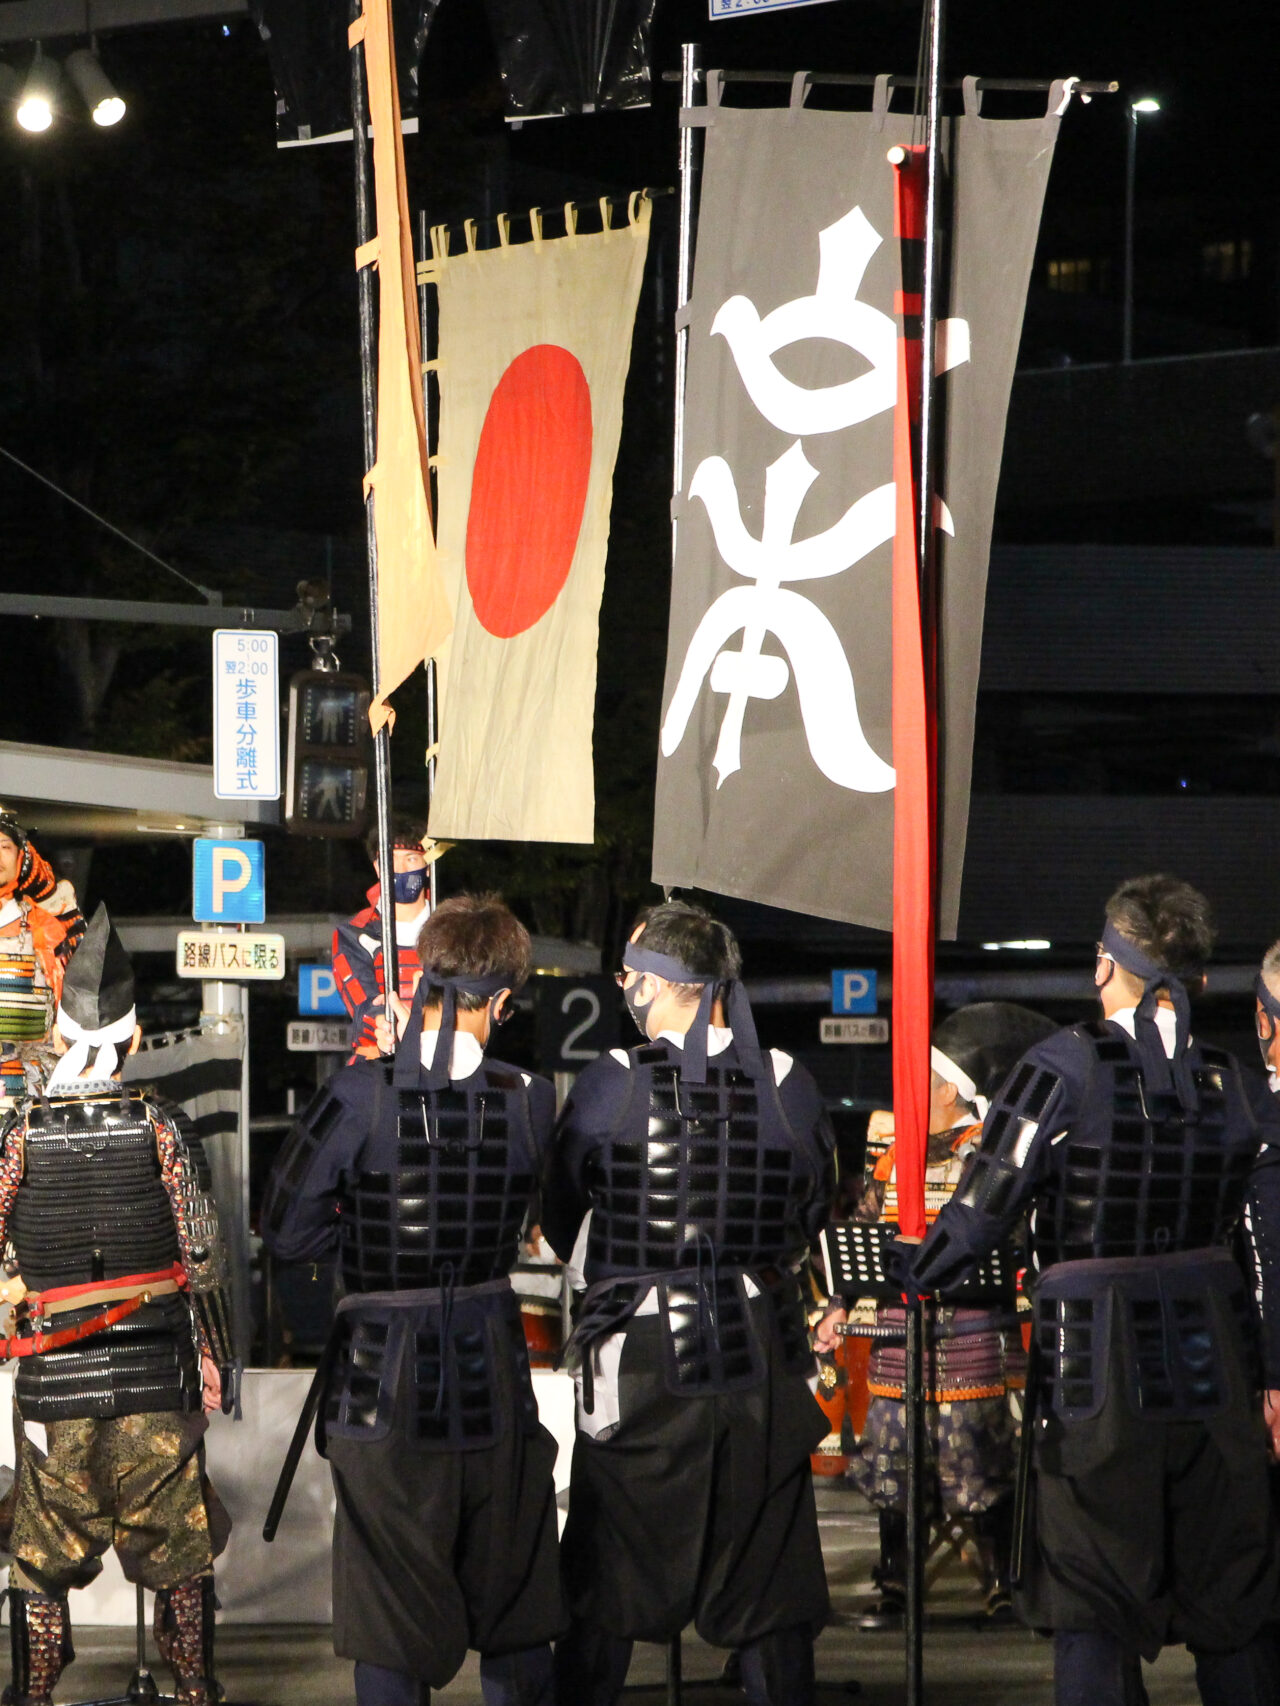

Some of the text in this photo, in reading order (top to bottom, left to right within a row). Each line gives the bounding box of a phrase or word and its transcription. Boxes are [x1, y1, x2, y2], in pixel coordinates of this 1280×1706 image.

[237, 638, 269, 653] 5:00
[225, 660, 269, 676] 翌2:00
[236, 678, 258, 791] 歩車分離式
[212, 847, 252, 913] P
[183, 942, 279, 969] 路線バスに限る
[311, 968, 336, 1010] P
[843, 974, 870, 1010] P
[561, 988, 600, 1060] 2
